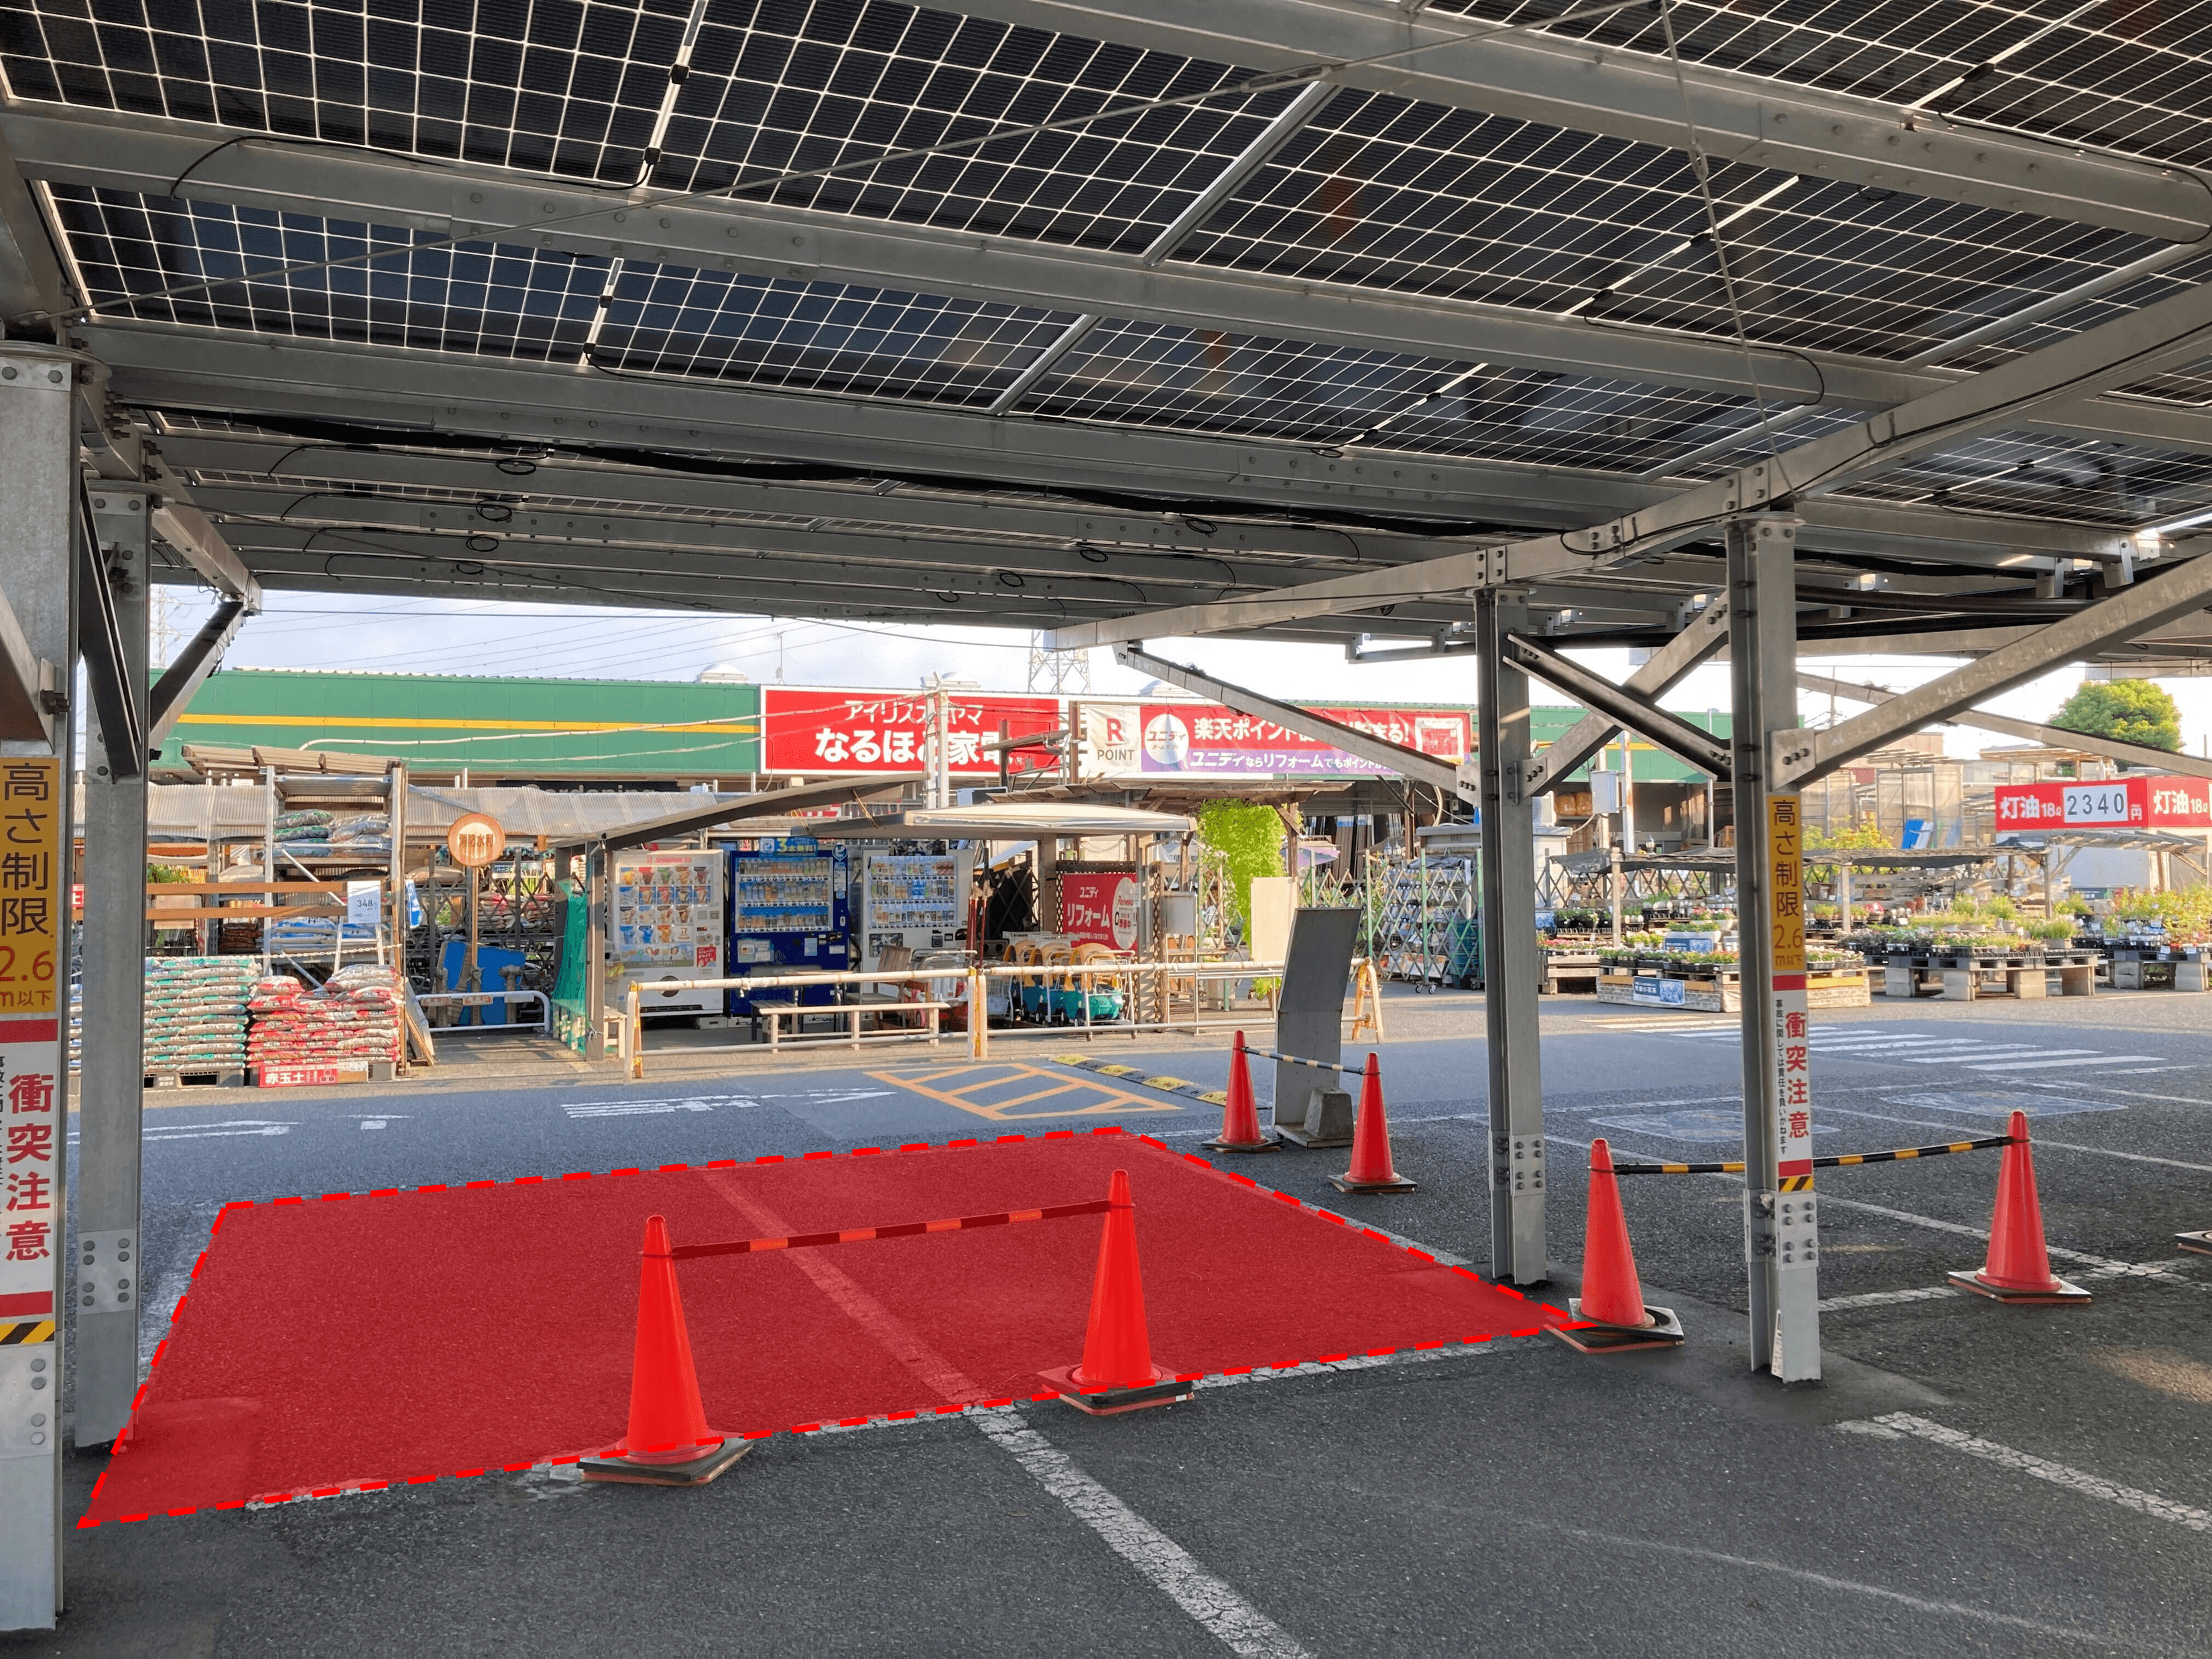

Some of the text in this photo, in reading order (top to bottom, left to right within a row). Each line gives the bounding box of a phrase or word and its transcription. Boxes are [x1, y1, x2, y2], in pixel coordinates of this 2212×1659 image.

[1097, 749, 1135, 761] POINT
[2067, 792, 2125, 816] 2340
[1, 762, 51, 936] 高さ制限
[459, 833, 494, 848] 消防水利
[1773, 799, 1800, 918] 高さ制限
[357, 899, 373, 908] 348
[1079, 886, 1099, 898] ユニディ
[1067, 903, 1111, 928] リフォーム
[1774, 924, 1803, 950] 2.6
[0, 945, 54, 981] 2.6
[265, 1071, 306, 1085] 赤玉土
[1775, 999, 1788, 1155] 事故に関しては責任を負いかねます
[1785, 1011, 1810, 1139] 衝突注意
[6, 1073, 55, 1262] 衝突注意
